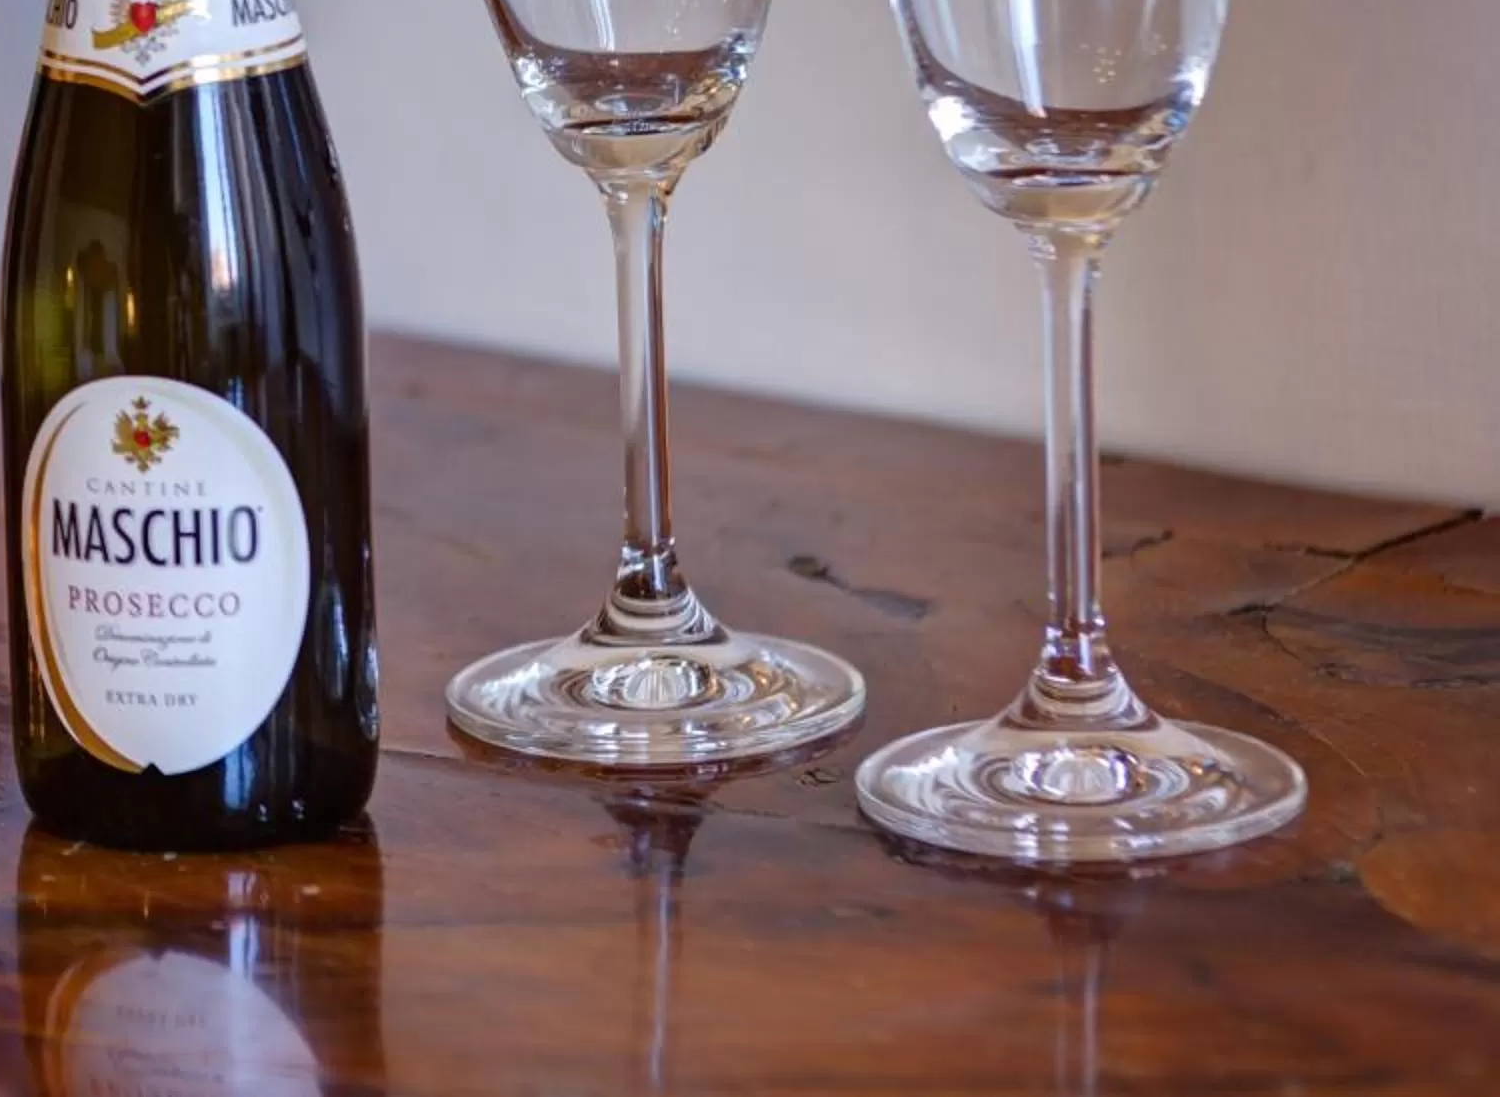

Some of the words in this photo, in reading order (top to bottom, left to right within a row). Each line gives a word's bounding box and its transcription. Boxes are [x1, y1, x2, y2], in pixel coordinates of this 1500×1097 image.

[86, 477, 209, 498] CANTINE
[51, 499, 259, 568] MASCHIO
[68, 584, 242, 619] PROSECCO
[105, 689, 157, 707] EXTRA
[163, 692, 198, 707] DRY
